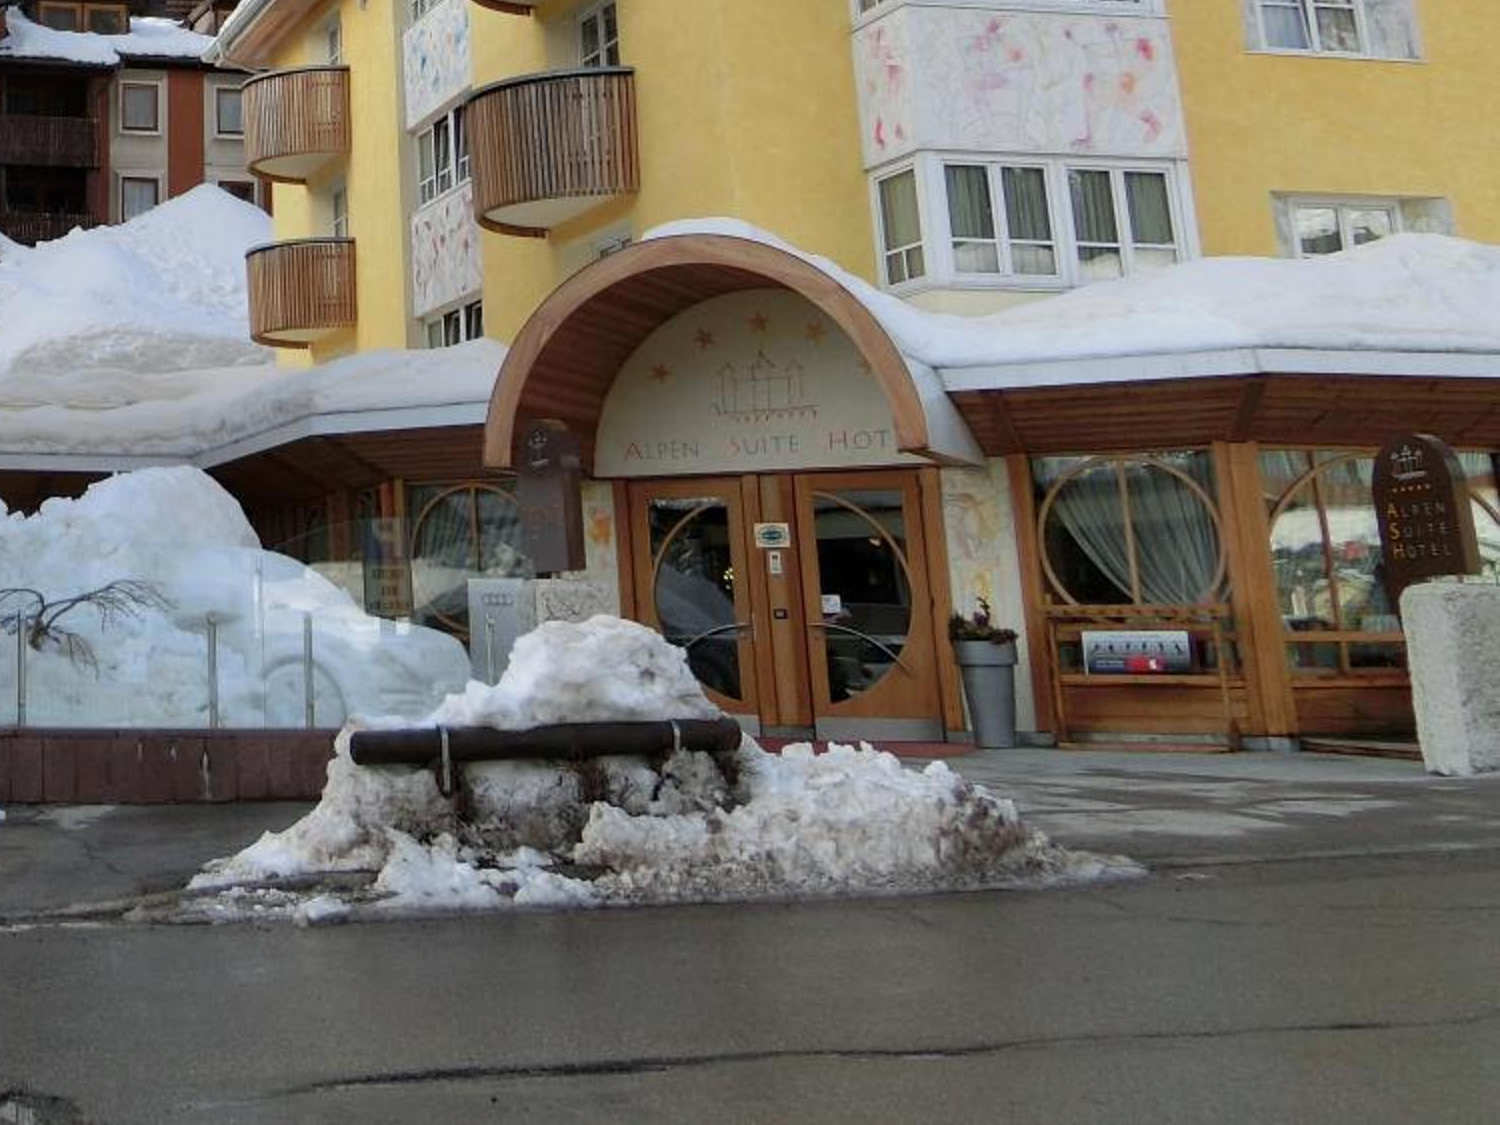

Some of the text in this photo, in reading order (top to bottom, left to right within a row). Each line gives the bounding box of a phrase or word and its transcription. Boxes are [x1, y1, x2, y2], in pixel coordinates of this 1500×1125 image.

[623, 441, 699, 460] ALPEN
[726, 434, 801, 456] SUITE
[1387, 501, 1445, 519] ALPEN
[1388, 522, 1448, 540] SUITE
[1393, 543, 1451, 559] HOTEL
